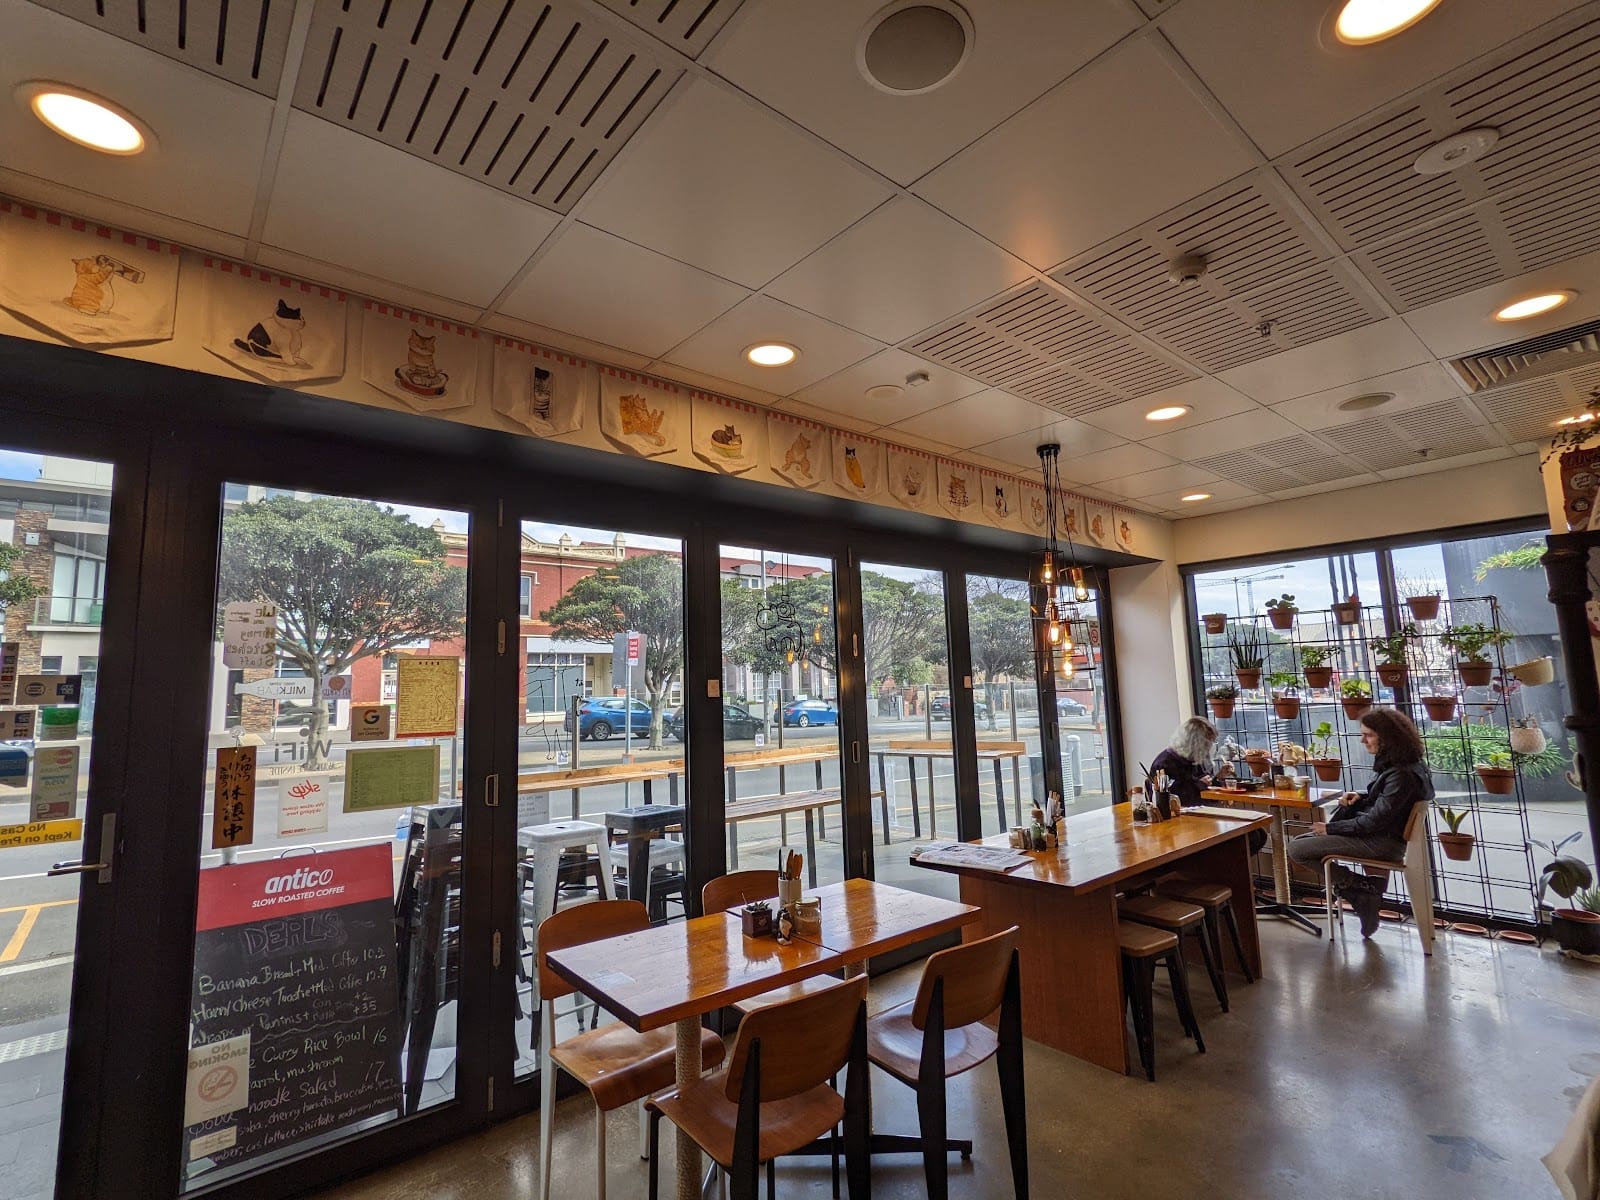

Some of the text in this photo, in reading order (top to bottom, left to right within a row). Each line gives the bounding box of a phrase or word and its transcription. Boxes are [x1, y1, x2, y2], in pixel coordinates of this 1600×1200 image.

[264, 867, 334, 894] antico
[252, 886, 345, 908] SLOW ROASTED COFFEE
[262, 1025, 387, 1063] Curry Rice Bowl 16
[300, 1070, 337, 1098] Salad
[365, 1061, 385, 1082] 17
